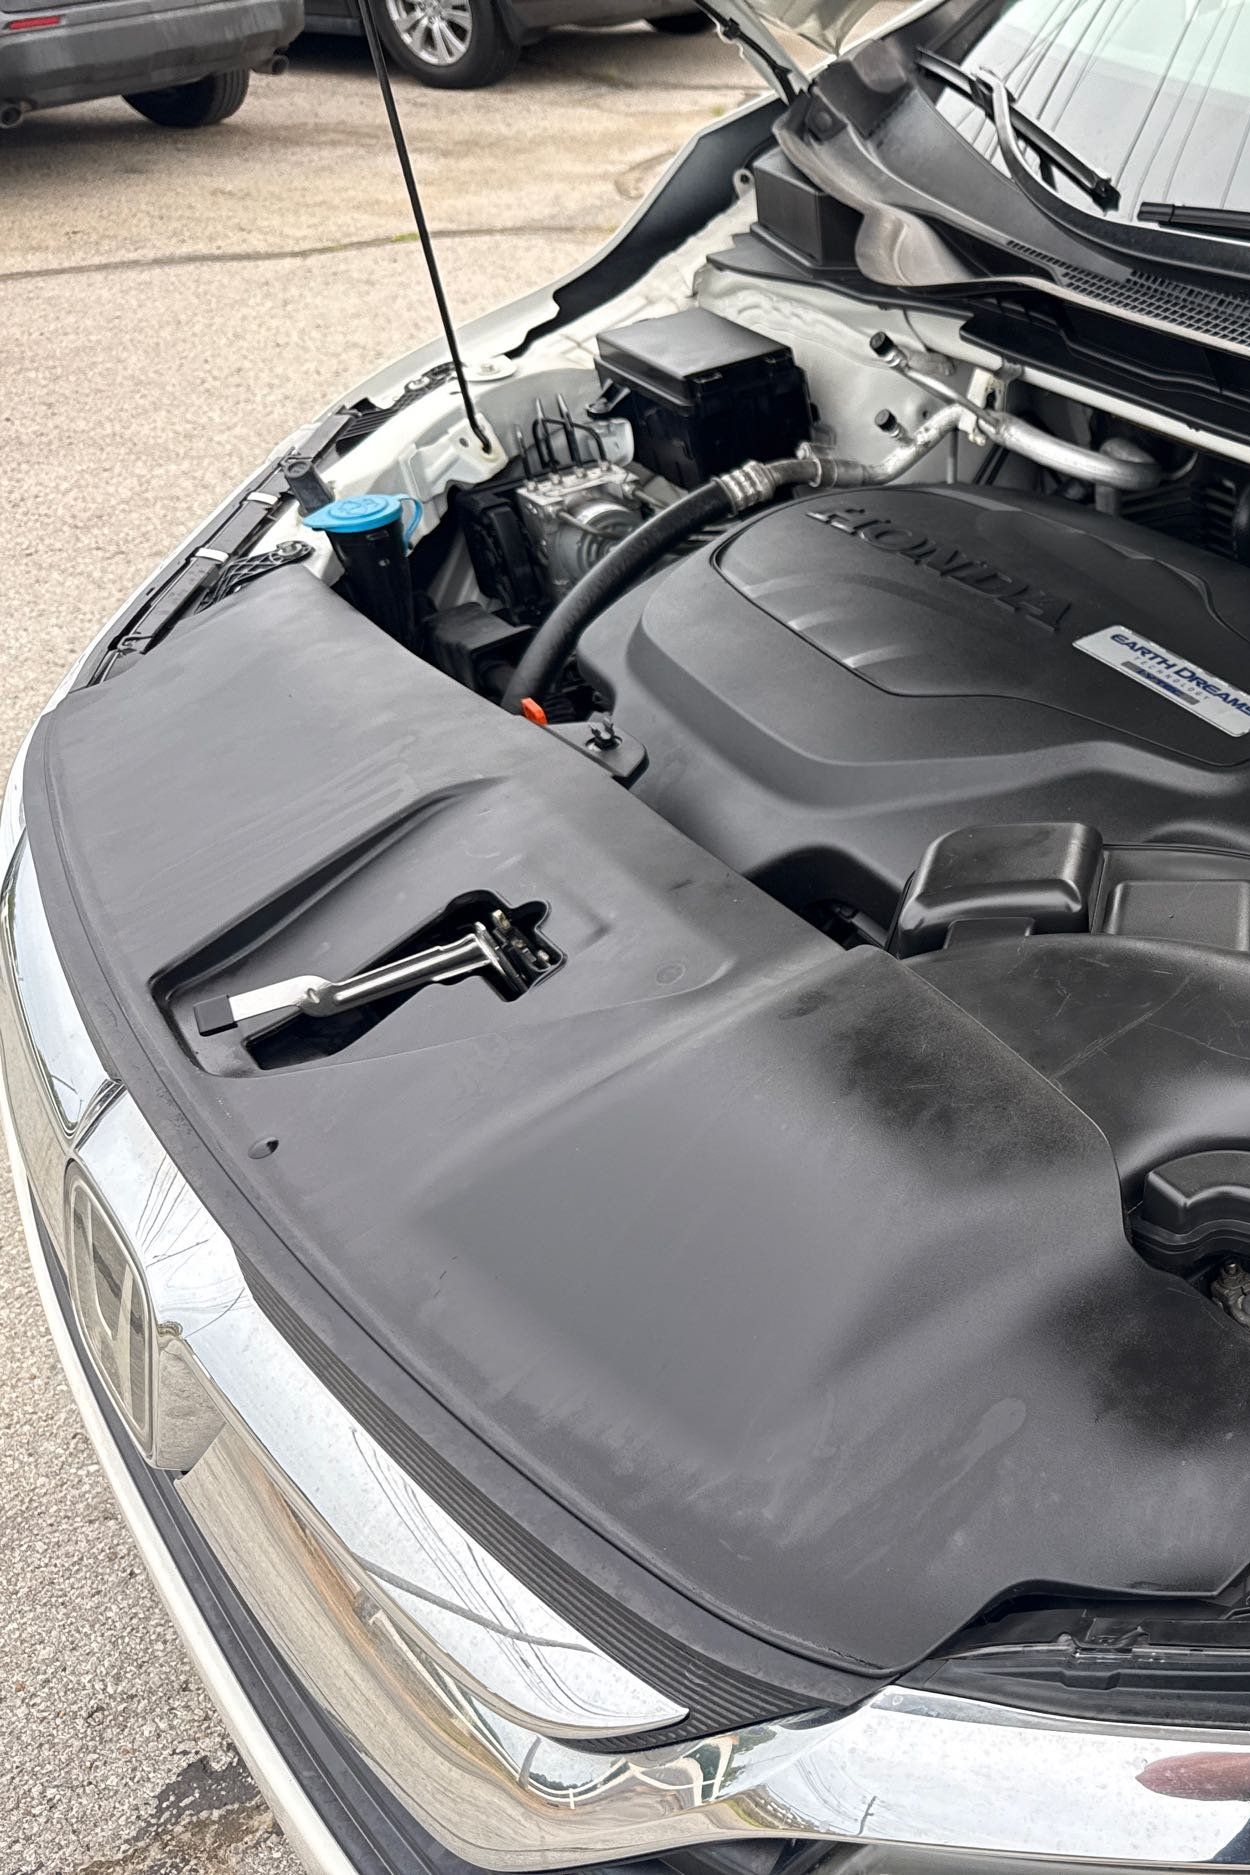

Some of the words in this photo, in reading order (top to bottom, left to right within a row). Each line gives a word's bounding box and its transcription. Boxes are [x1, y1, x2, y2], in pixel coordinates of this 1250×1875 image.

[806, 508, 1072, 632] HONDA
[1110, 633, 1178, 670] EARTH
[1134, 656, 1209, 701] TECHNOLOGY
